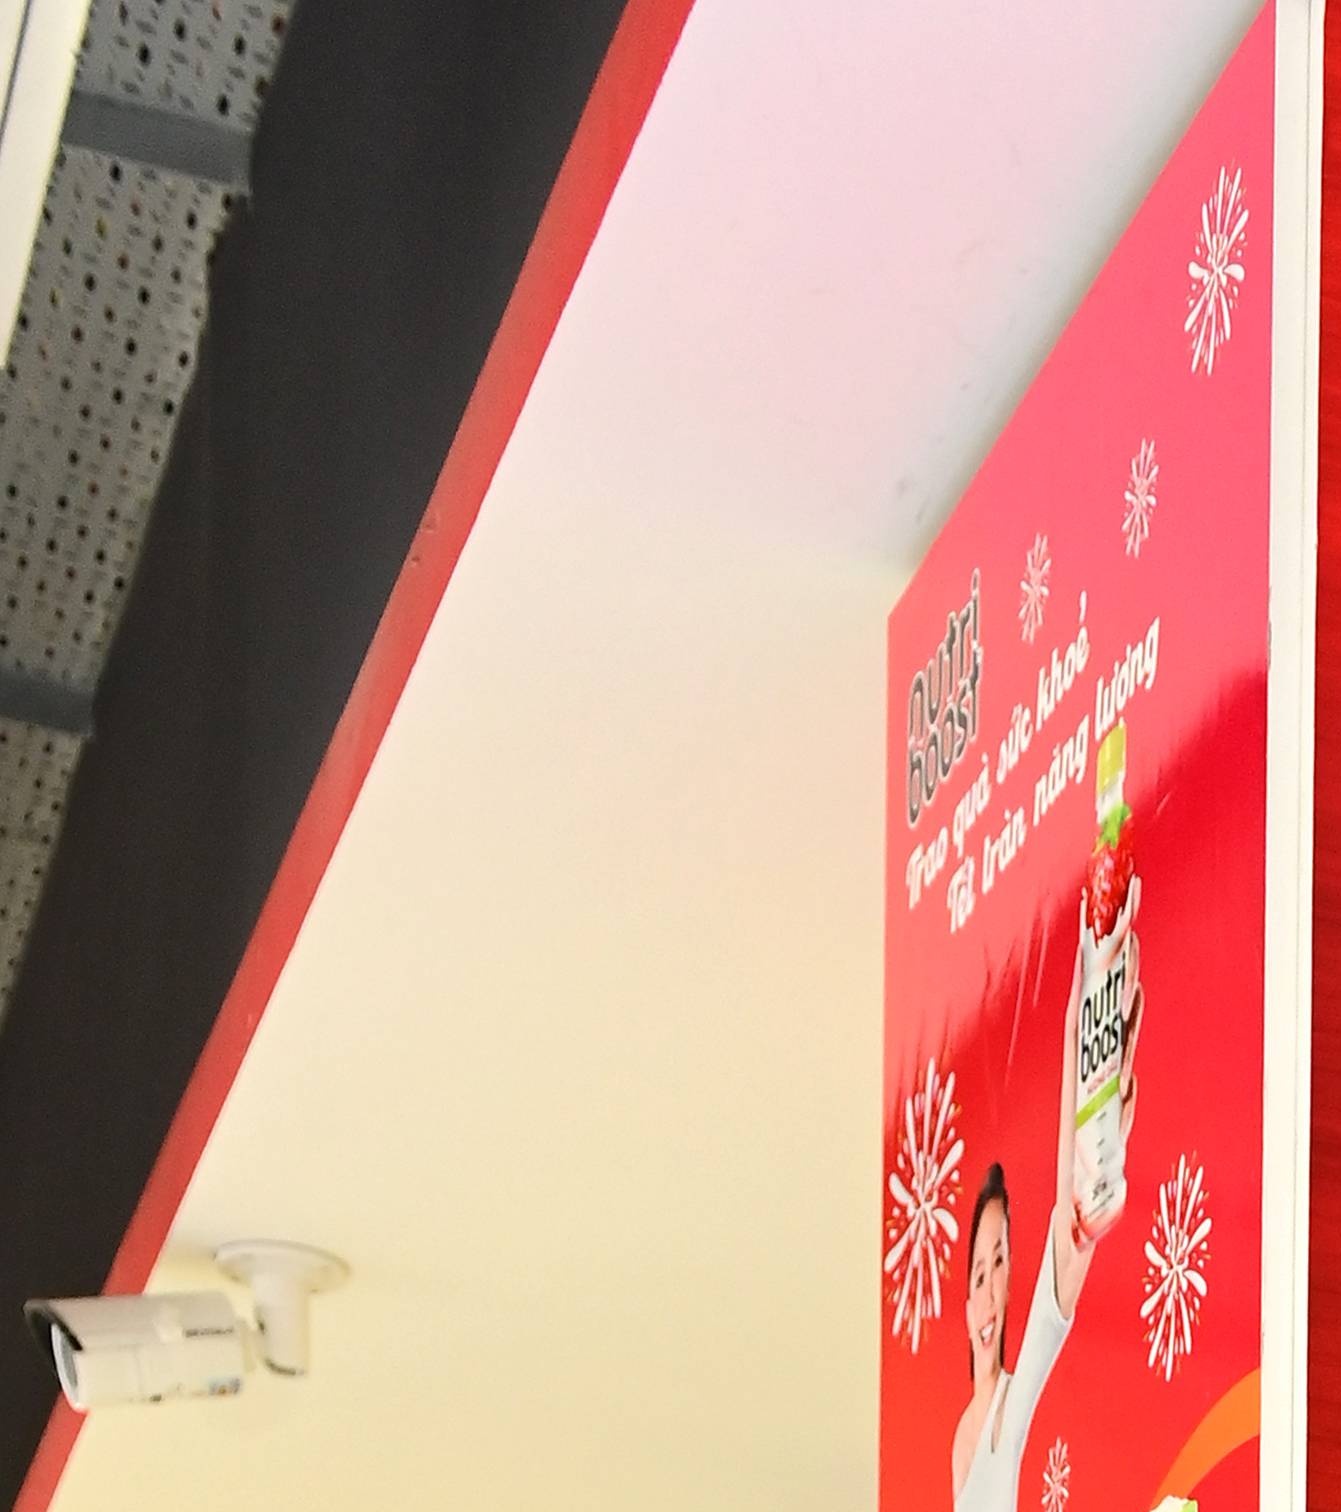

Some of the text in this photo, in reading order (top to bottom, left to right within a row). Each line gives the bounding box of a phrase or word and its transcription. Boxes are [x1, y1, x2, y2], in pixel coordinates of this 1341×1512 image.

[908, 567, 981, 733] nutri
[906, 828, 947, 910] Trao
[997, 702, 1034, 785] sức
[907, 654, 981, 826] boost
[946, 616, 1161, 934] Tết tràn năng lượng
[1079, 952, 1127, 1031] nutri
[1079, 1012, 1127, 1084] boost
